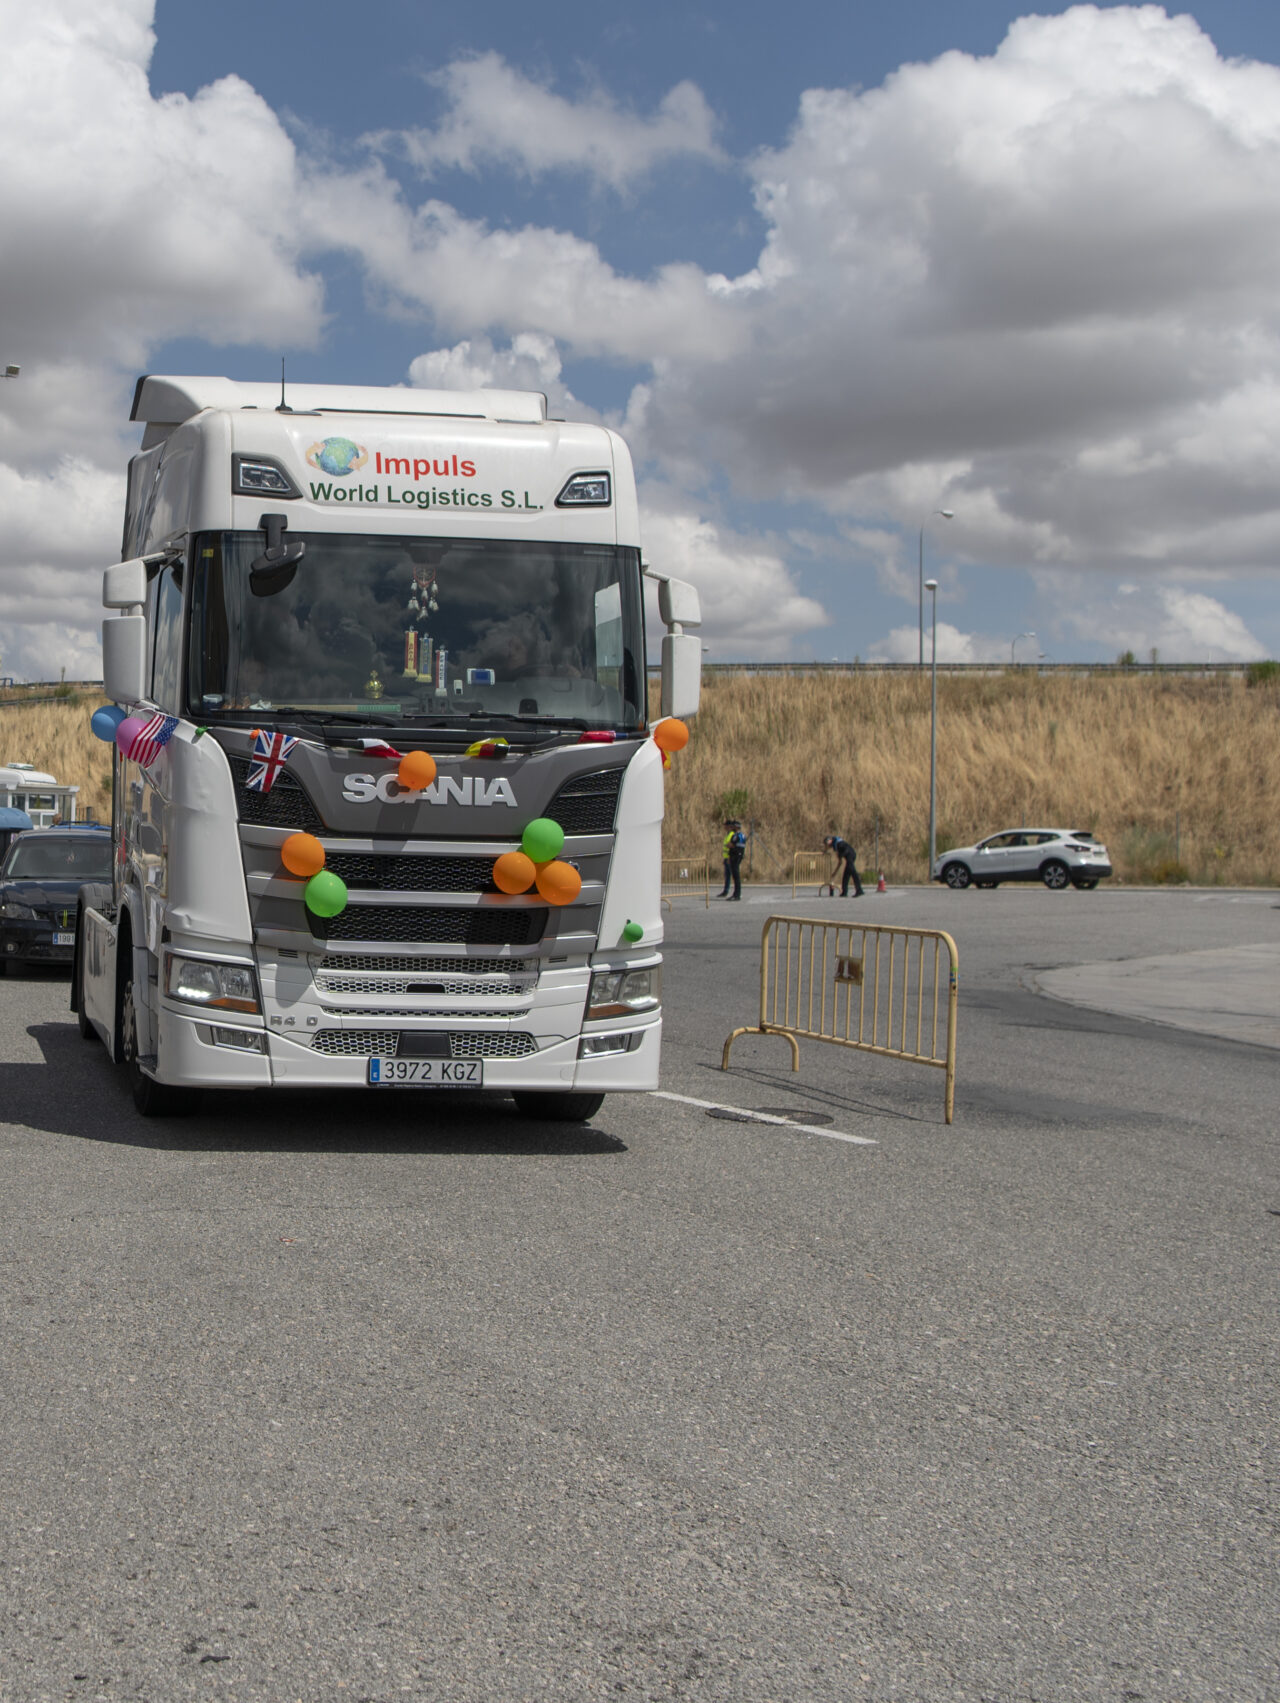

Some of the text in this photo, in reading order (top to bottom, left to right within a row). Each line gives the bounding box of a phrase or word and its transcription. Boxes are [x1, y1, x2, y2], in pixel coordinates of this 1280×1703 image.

[376, 452, 477, 481] Impuls
[309, 482, 544, 510] World Logistics S.L.
[385, 1061, 477, 1081] 3972 KGZ
